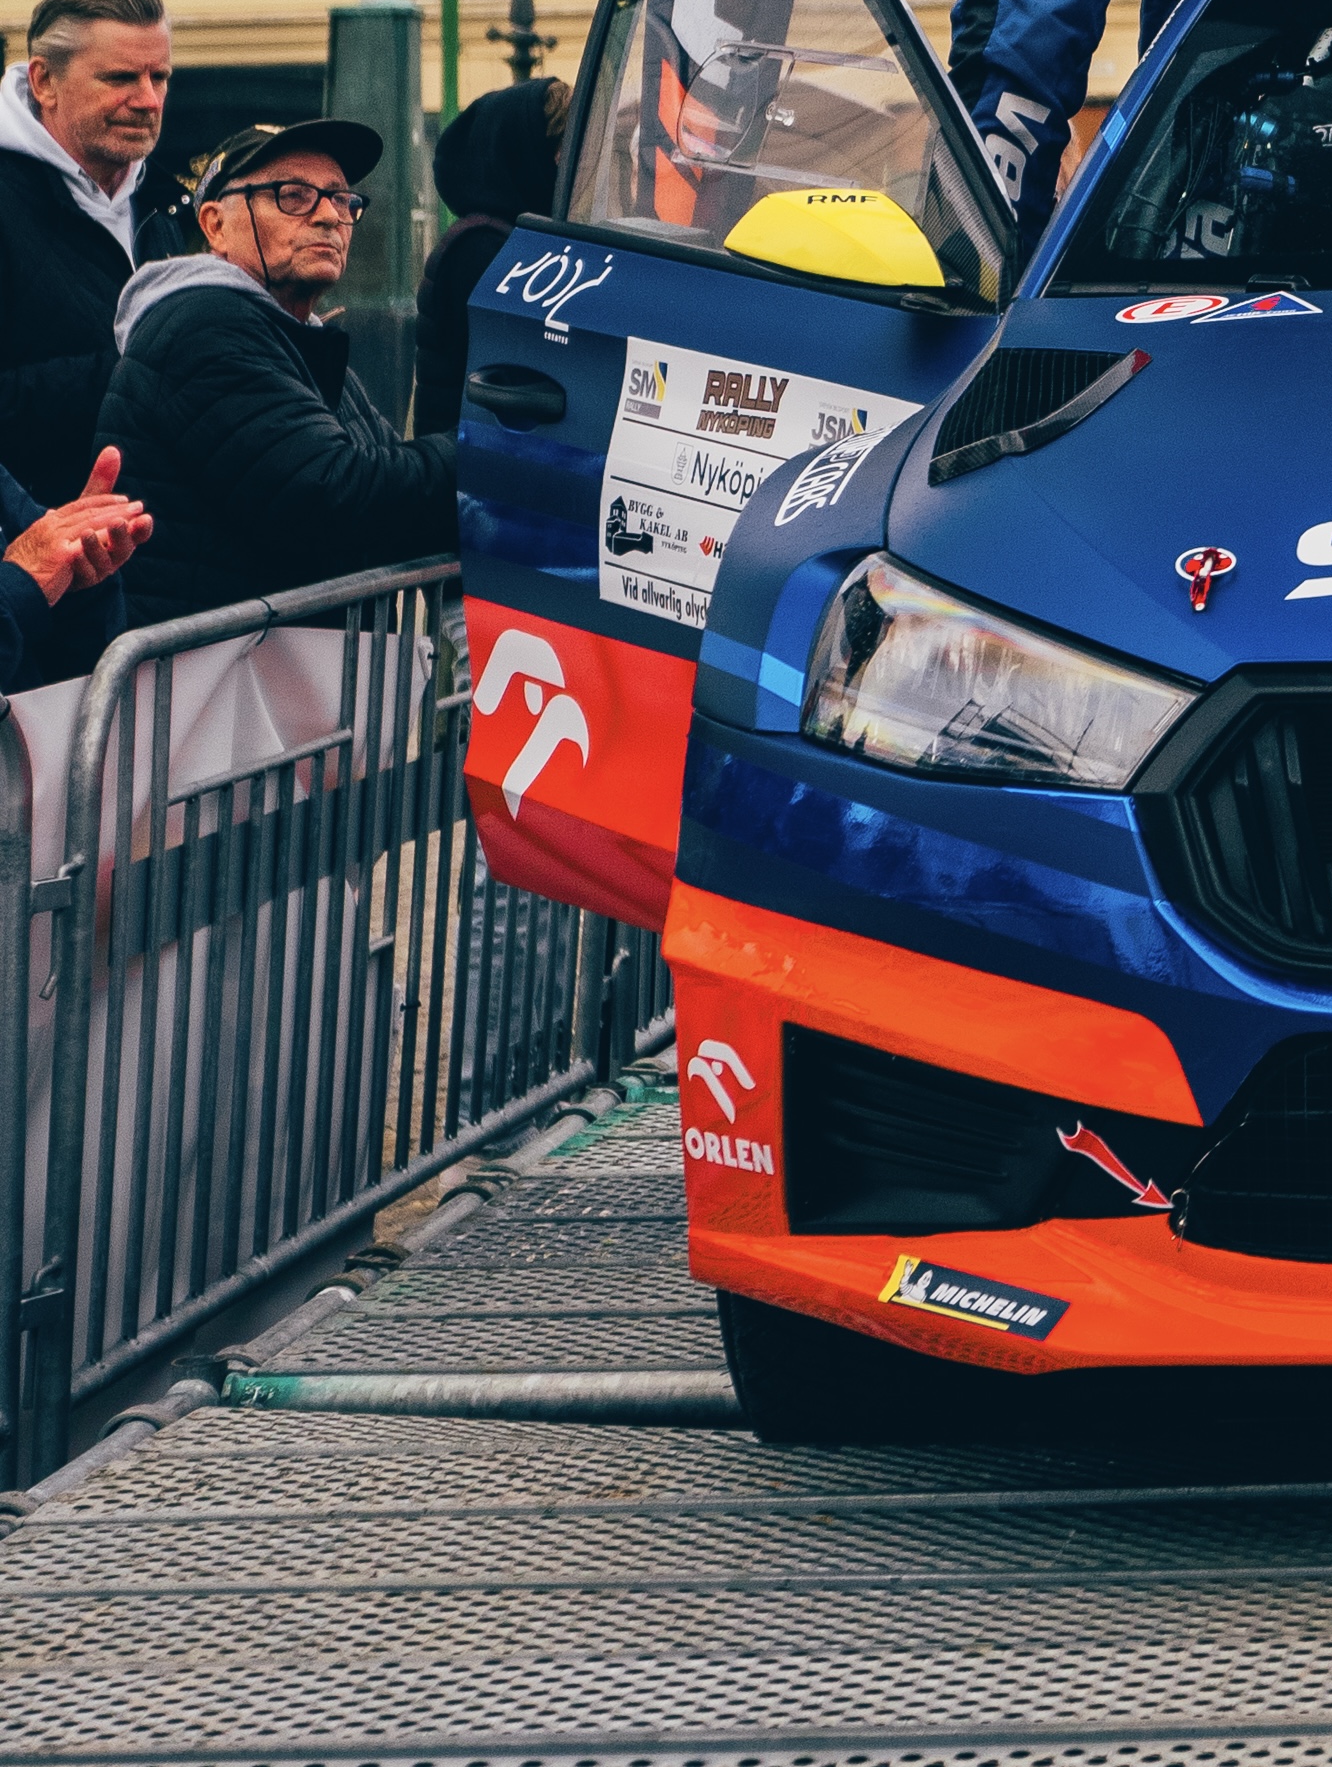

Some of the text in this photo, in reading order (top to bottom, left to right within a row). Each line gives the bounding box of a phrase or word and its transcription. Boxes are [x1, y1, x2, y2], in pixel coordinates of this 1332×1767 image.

[807, 194, 878, 205] RMF
[1151, 300, 1197, 314] E
[628, 367, 656, 400] SM
[702, 369, 790, 413] RALLY
[696, 410, 776, 439] NYKÖPING
[691, 451, 764, 504] Nyköpi
[628, 500, 664, 519] BYGG &
[640, 518, 688, 542] KAKEL AB
[622, 574, 638, 601] Vid
[642, 581, 682, 620] allvarlig
[685, 1128, 774, 1175] ORLEN
[930, 1281, 1050, 1327] MICHELIN
